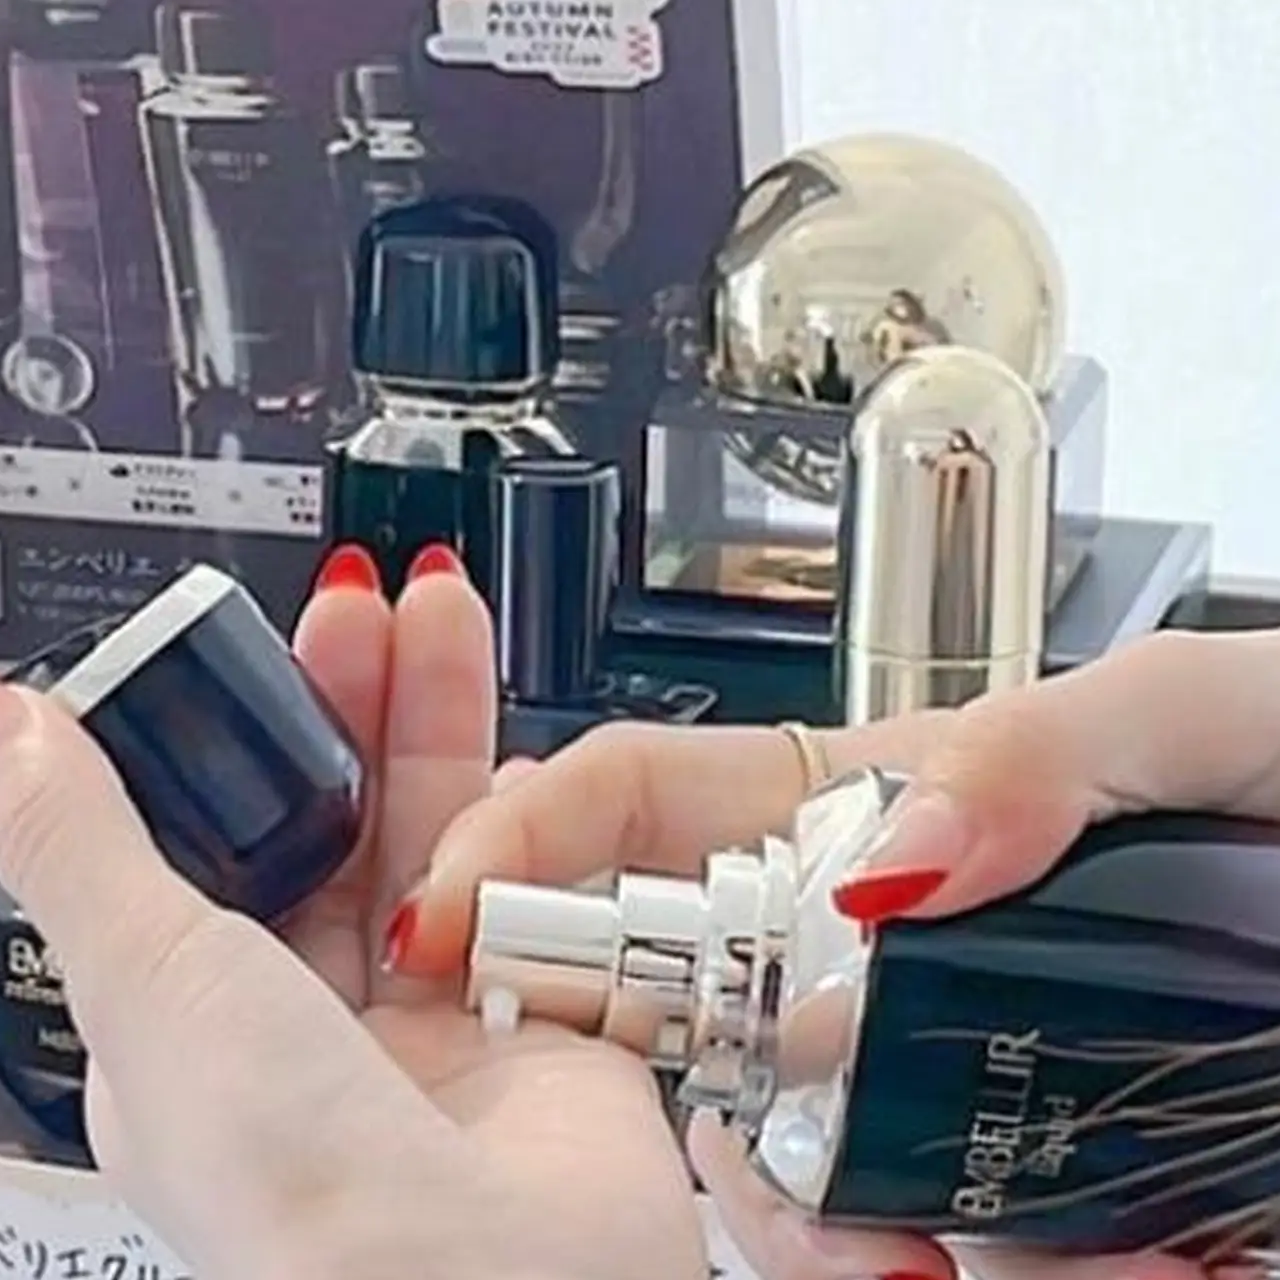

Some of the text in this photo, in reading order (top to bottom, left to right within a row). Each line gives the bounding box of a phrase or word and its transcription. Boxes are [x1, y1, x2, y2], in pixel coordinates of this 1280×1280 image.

[486, 0, 614, 19] AUTUMN
[487, 20, 617, 39] FESTIVAL
[950, 1025, 1042, 1220] EMBELLIR
